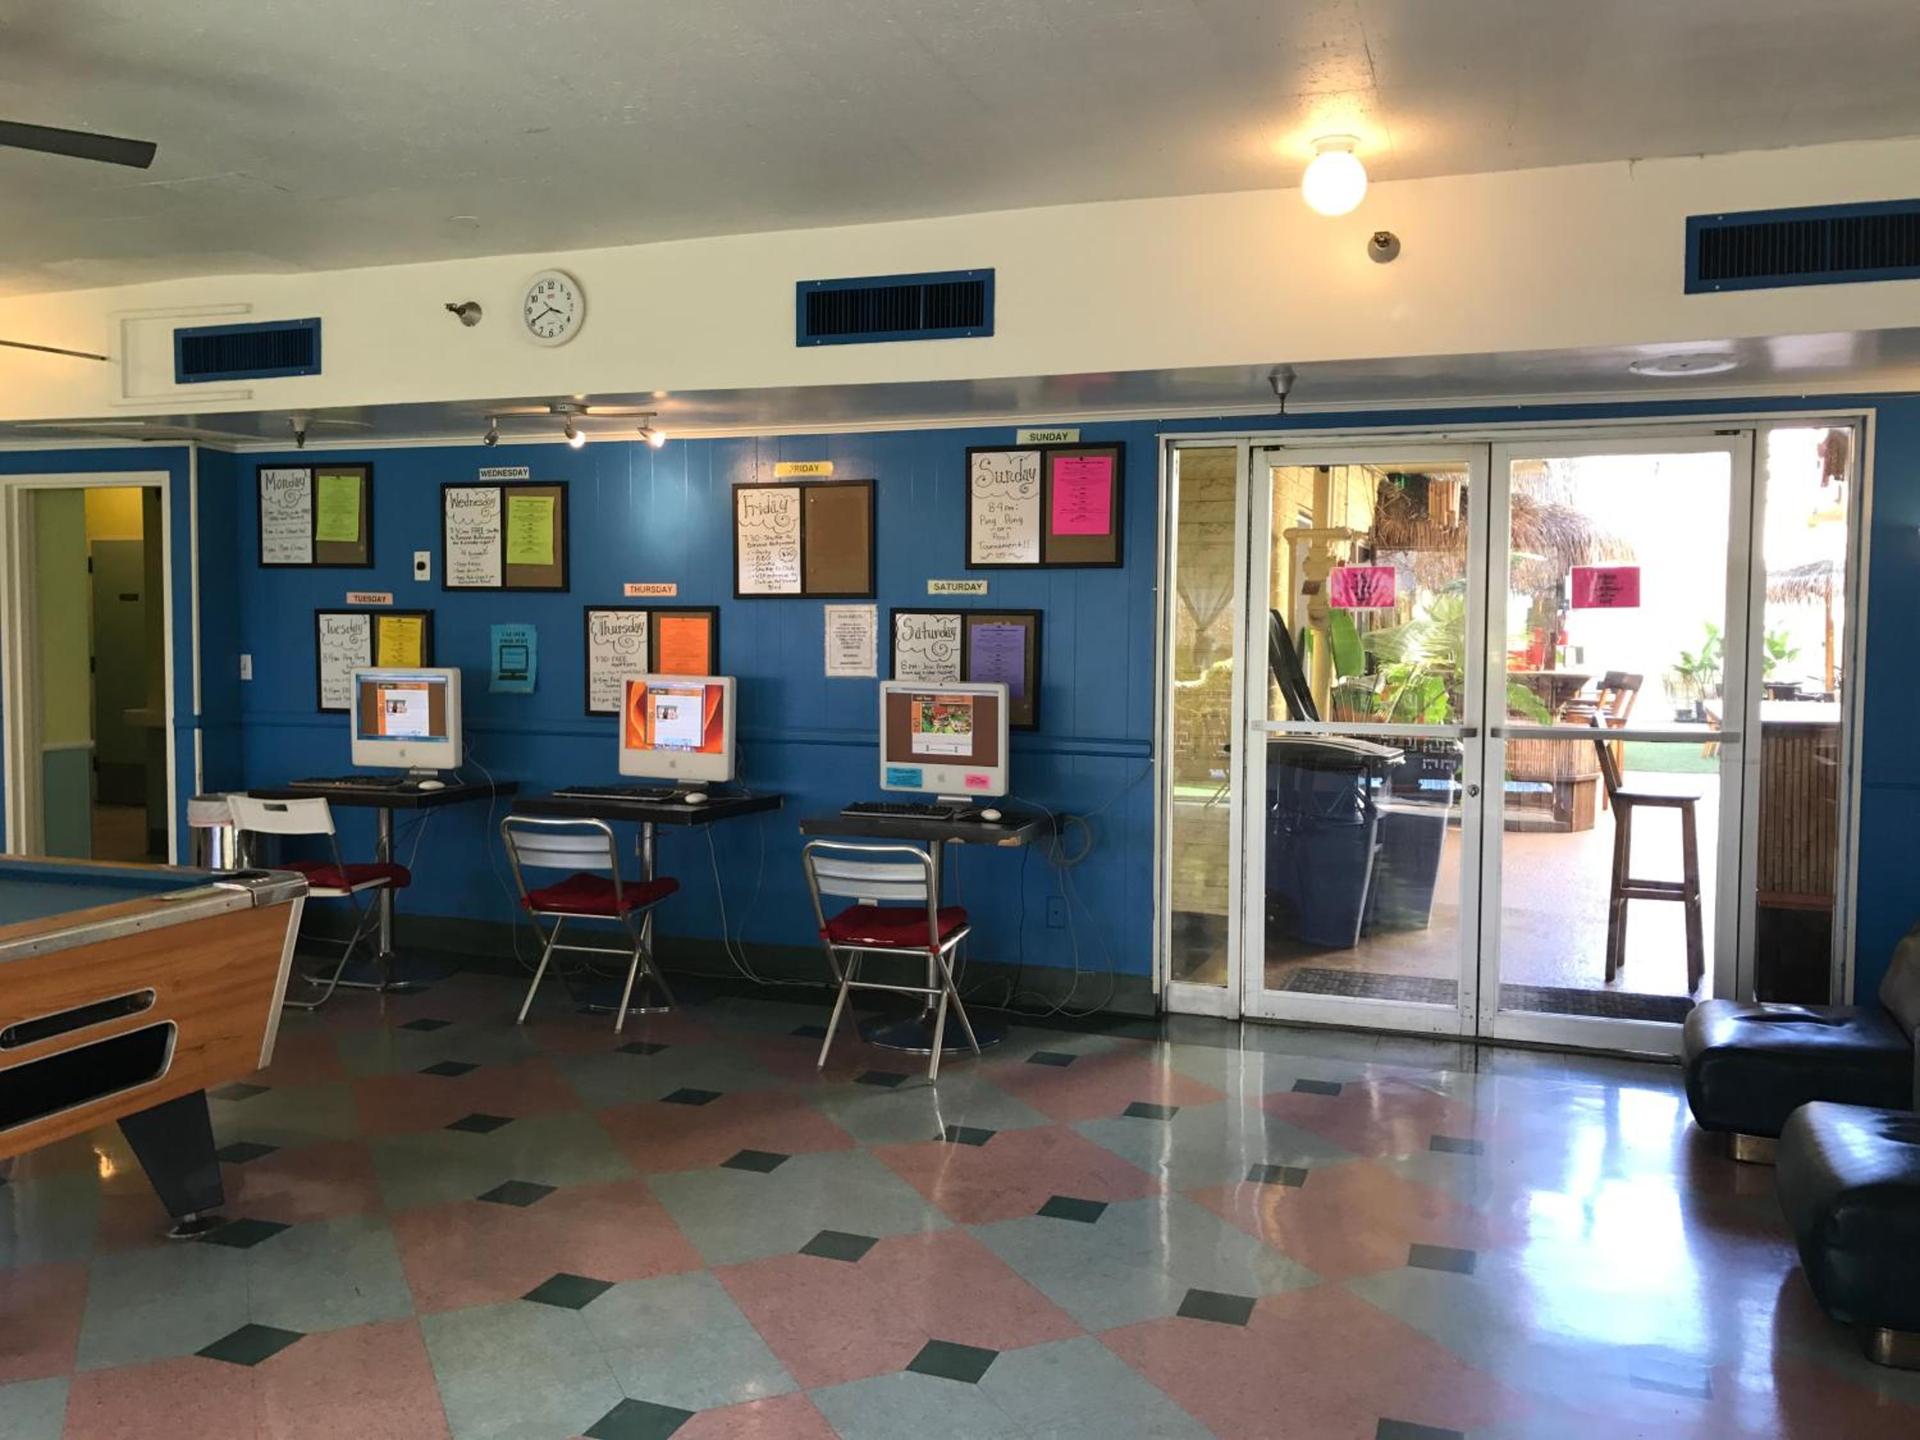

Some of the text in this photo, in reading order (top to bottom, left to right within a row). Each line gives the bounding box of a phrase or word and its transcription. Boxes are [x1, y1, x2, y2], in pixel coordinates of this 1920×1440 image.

[538, 286, 544, 294] 11
[547, 280, 555, 290] 12
[531, 295, 539, 303] 10
[566, 291, 572, 300] 2
[539, 326, 544, 335] 7
[549, 328, 554, 337] 6
[559, 324, 564, 334] 5
[1029, 432, 1069, 442] SUNDAY
[481, 468, 528, 478] WEDNESDAY
[789, 464, 819, 473] FRIDAY
[975, 457, 1036, 494] Sunday
[265, 472, 306, 491] Monday
[450, 492, 496, 509] Wednesday
[743, 494, 788, 519] Friday
[630, 585, 673, 593] THURSDAY
[933, 582, 983, 591] SATURDAY
[353, 594, 386, 603] TUESDAY
[324, 618, 363, 635] Tuesday
[594, 615, 645, 636] Thursday
[902, 617, 957, 642] Saturday
